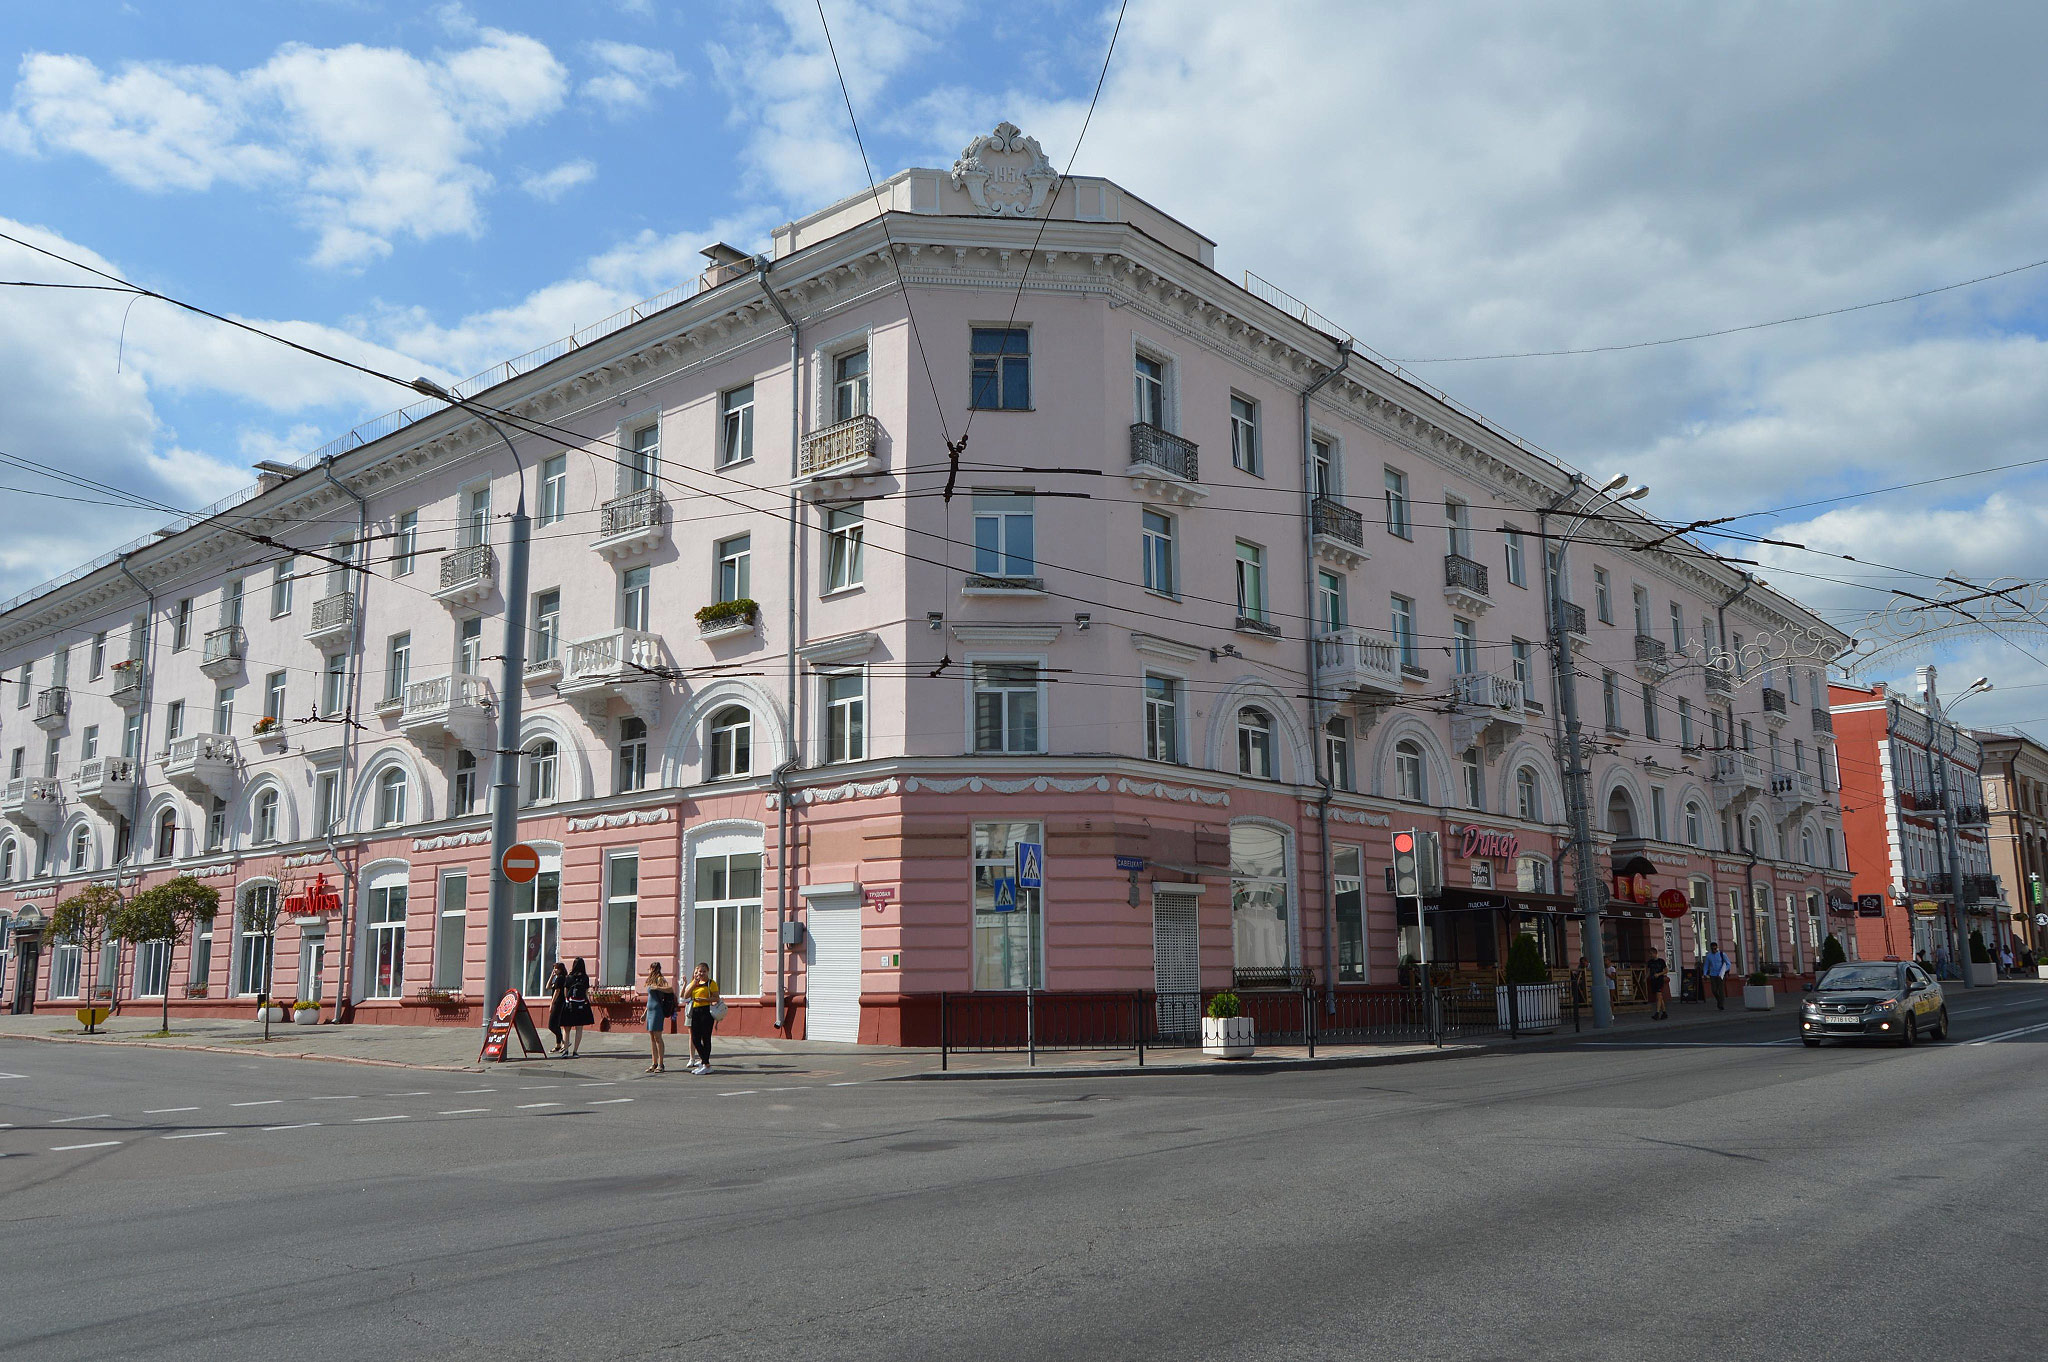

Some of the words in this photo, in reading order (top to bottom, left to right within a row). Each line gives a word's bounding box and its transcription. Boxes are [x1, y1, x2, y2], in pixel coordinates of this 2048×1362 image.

[993, 166, 1025, 183] 1954
[1463, 825, 1520, 873] Динер
[877, 903, 882, 911] 3
